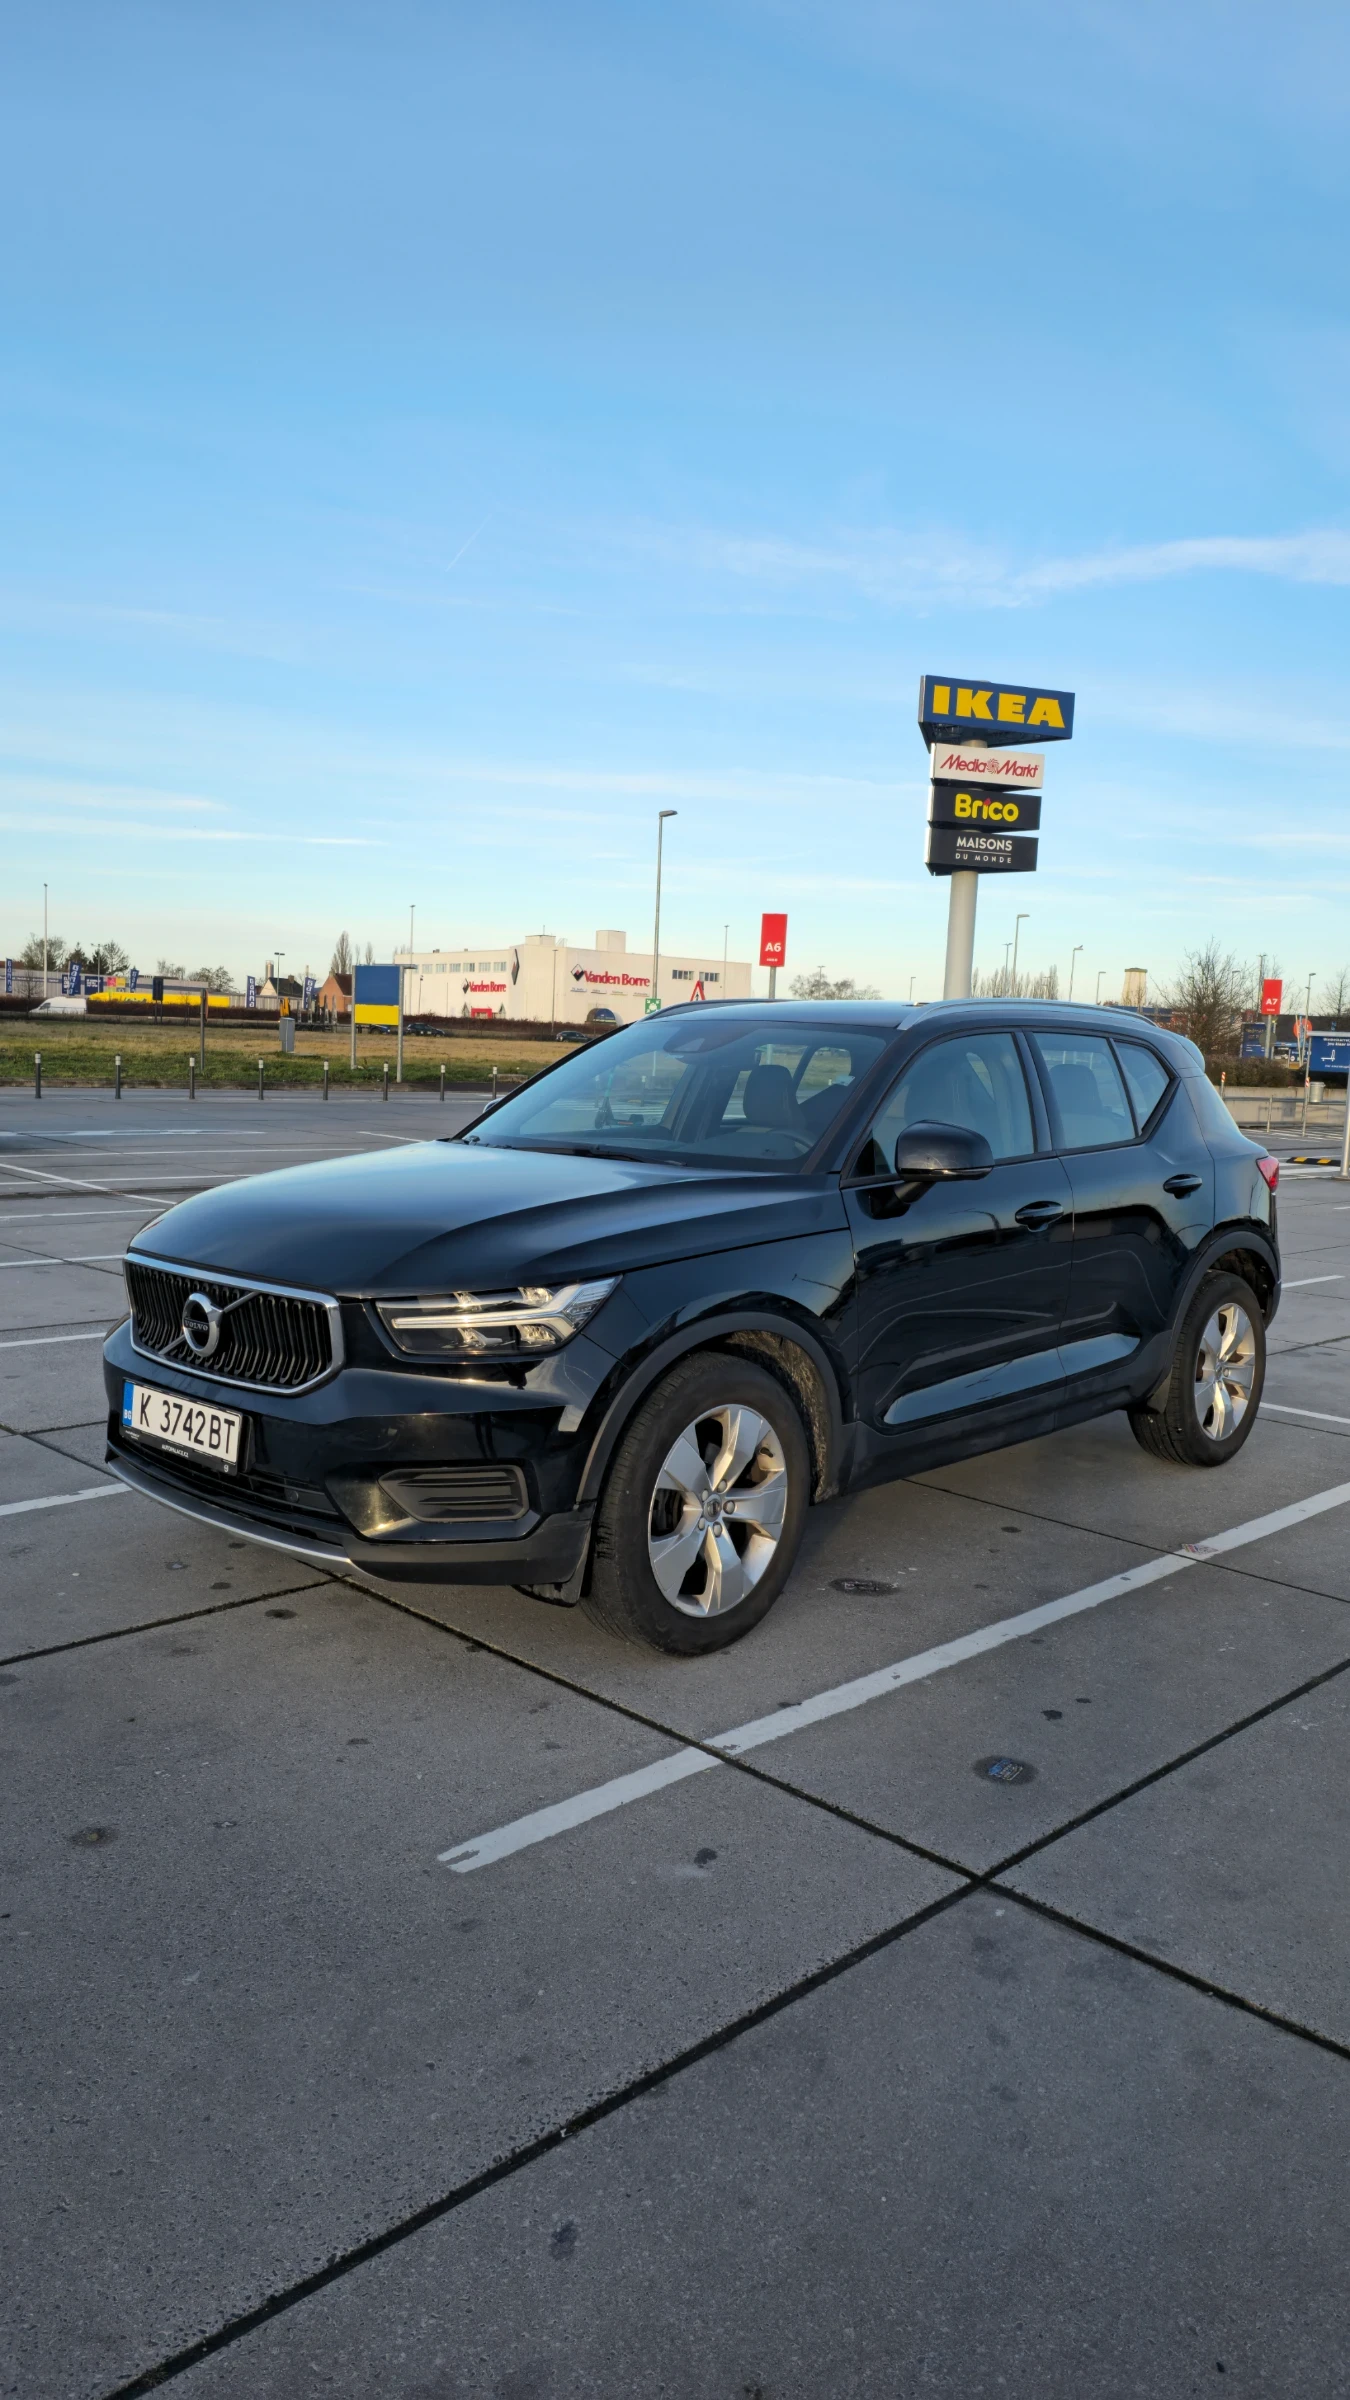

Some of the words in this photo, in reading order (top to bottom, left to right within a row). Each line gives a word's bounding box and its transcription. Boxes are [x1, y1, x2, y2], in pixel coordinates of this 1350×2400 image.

[932, 685, 1065, 728] IKEA
[940, 754, 987, 773] Media
[997, 760, 1039, 778] Markt
[954, 793, 1019, 822] Brico
[956, 836, 1013, 851] MAISONS
[955, 852, 968, 861] DU
[975, 853, 1012, 864] MONDE
[765, 942, 782, 952] A6
[584, 970, 620, 985] Vanden
[622, 973, 651, 987] Borre
[469, 980, 490, 992] Vanden
[490, 981, 506, 992] Borre
[1265, 998, 1278, 1006] A7
[184, 1319, 208, 1331] VOLVO
[123, 1409, 132, 1420] BG
[140, 1392, 151, 1427] K
[160, 1400, 236, 1454] 3742BT
